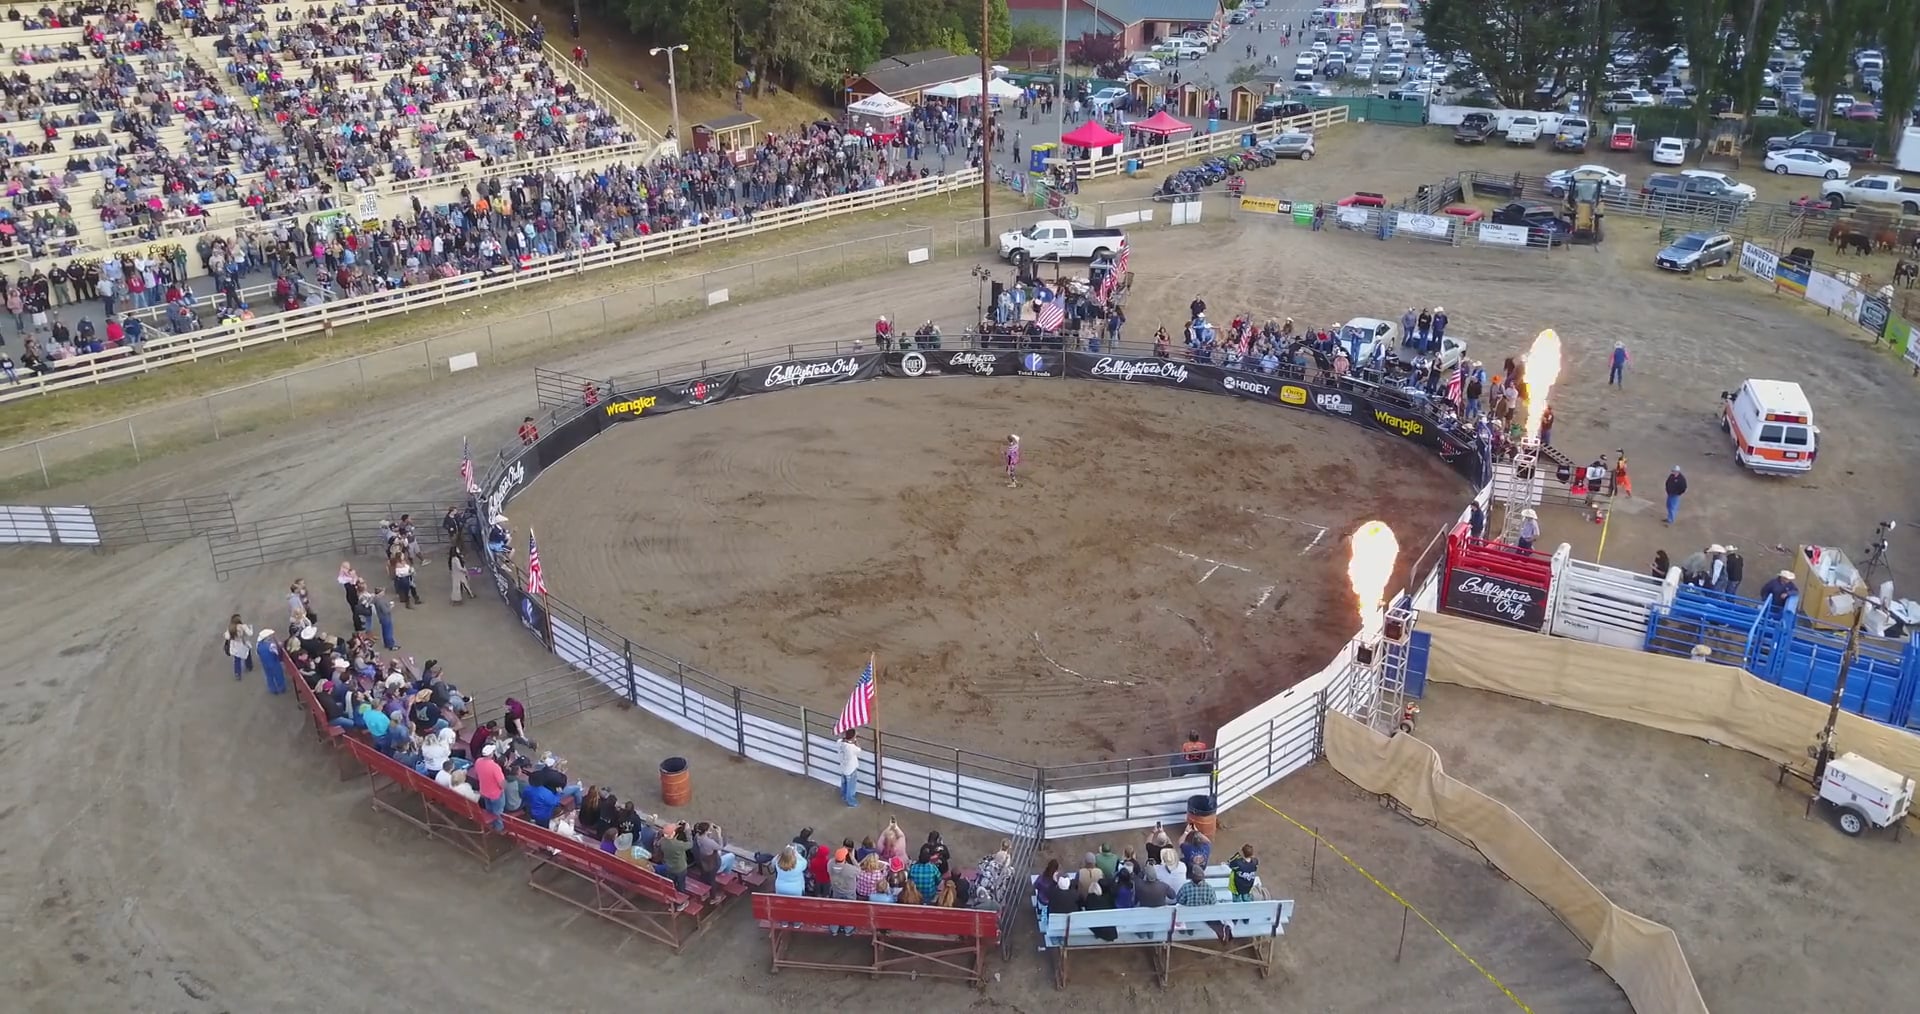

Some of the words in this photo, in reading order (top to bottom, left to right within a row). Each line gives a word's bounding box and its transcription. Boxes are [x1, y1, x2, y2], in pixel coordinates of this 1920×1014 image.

[1278, 203, 1291, 212] CAT
[831, 357, 859, 376] Only
[974, 362, 994, 376] Only
[1160, 362, 1188, 383] Only
[1235, 379, 1271, 395] HOOEY
[606, 395, 657, 417] Wrangler
[1496, 600, 1526, 620] Only
